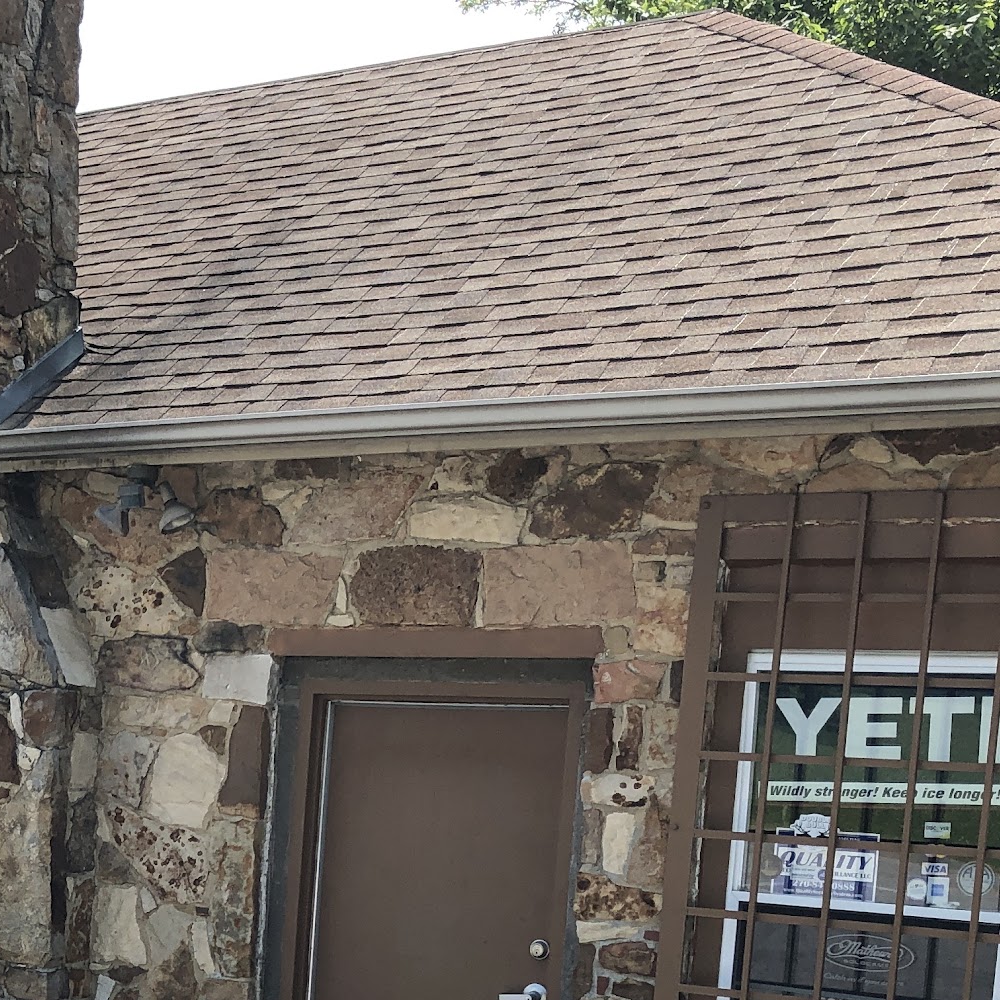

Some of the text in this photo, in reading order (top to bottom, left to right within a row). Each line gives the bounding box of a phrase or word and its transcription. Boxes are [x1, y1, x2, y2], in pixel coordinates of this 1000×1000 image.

[775, 696, 1000, 764] YETI
[770, 785, 812, 798] Wildly
[815, 786, 879, 799] strnger!
[922, 788, 945, 799] ice
[781, 850, 873, 870] QUAITY
[925, 865, 947, 873] VISA
